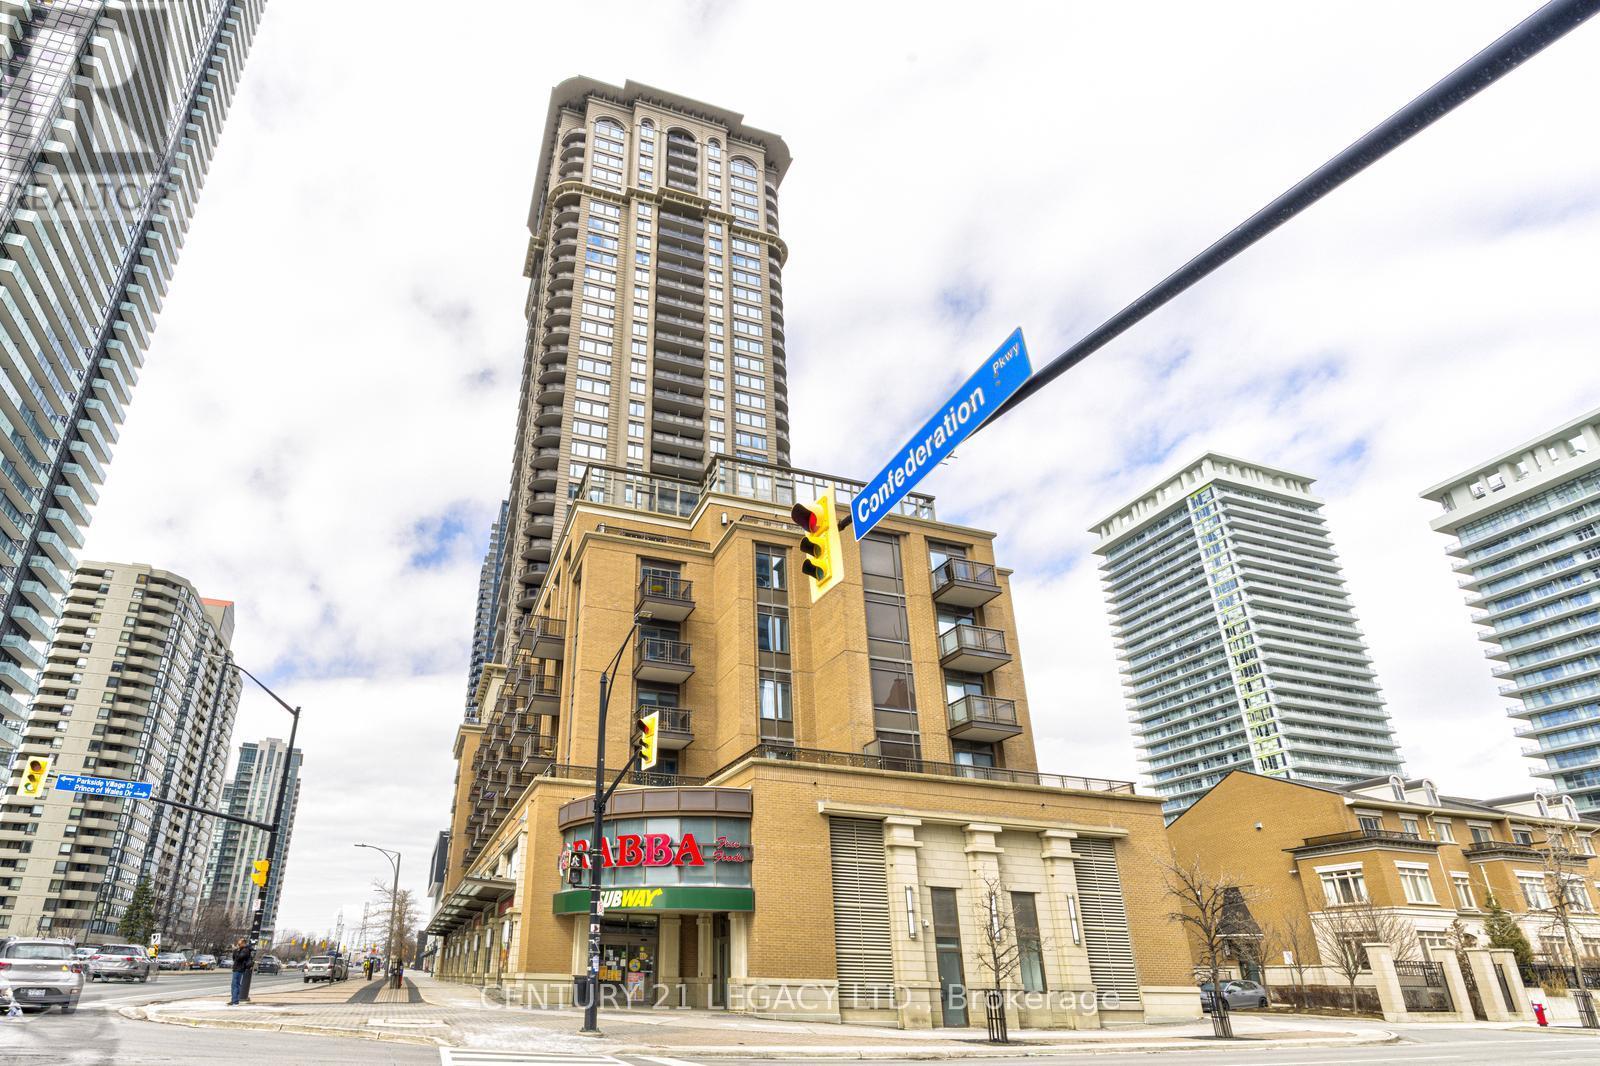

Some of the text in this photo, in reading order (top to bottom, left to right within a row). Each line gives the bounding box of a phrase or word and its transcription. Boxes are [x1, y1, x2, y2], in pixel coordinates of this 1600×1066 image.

[992, 342, 1019, 376] Pkwy
[857, 386, 985, 523] Confederation
[74, 784, 95, 793] Prince
[104, 787, 123, 796] Wales
[124, 789, 132, 797] Dr
[76, 777, 104, 787] Parkside
[105, 780, 126, 789] Village
